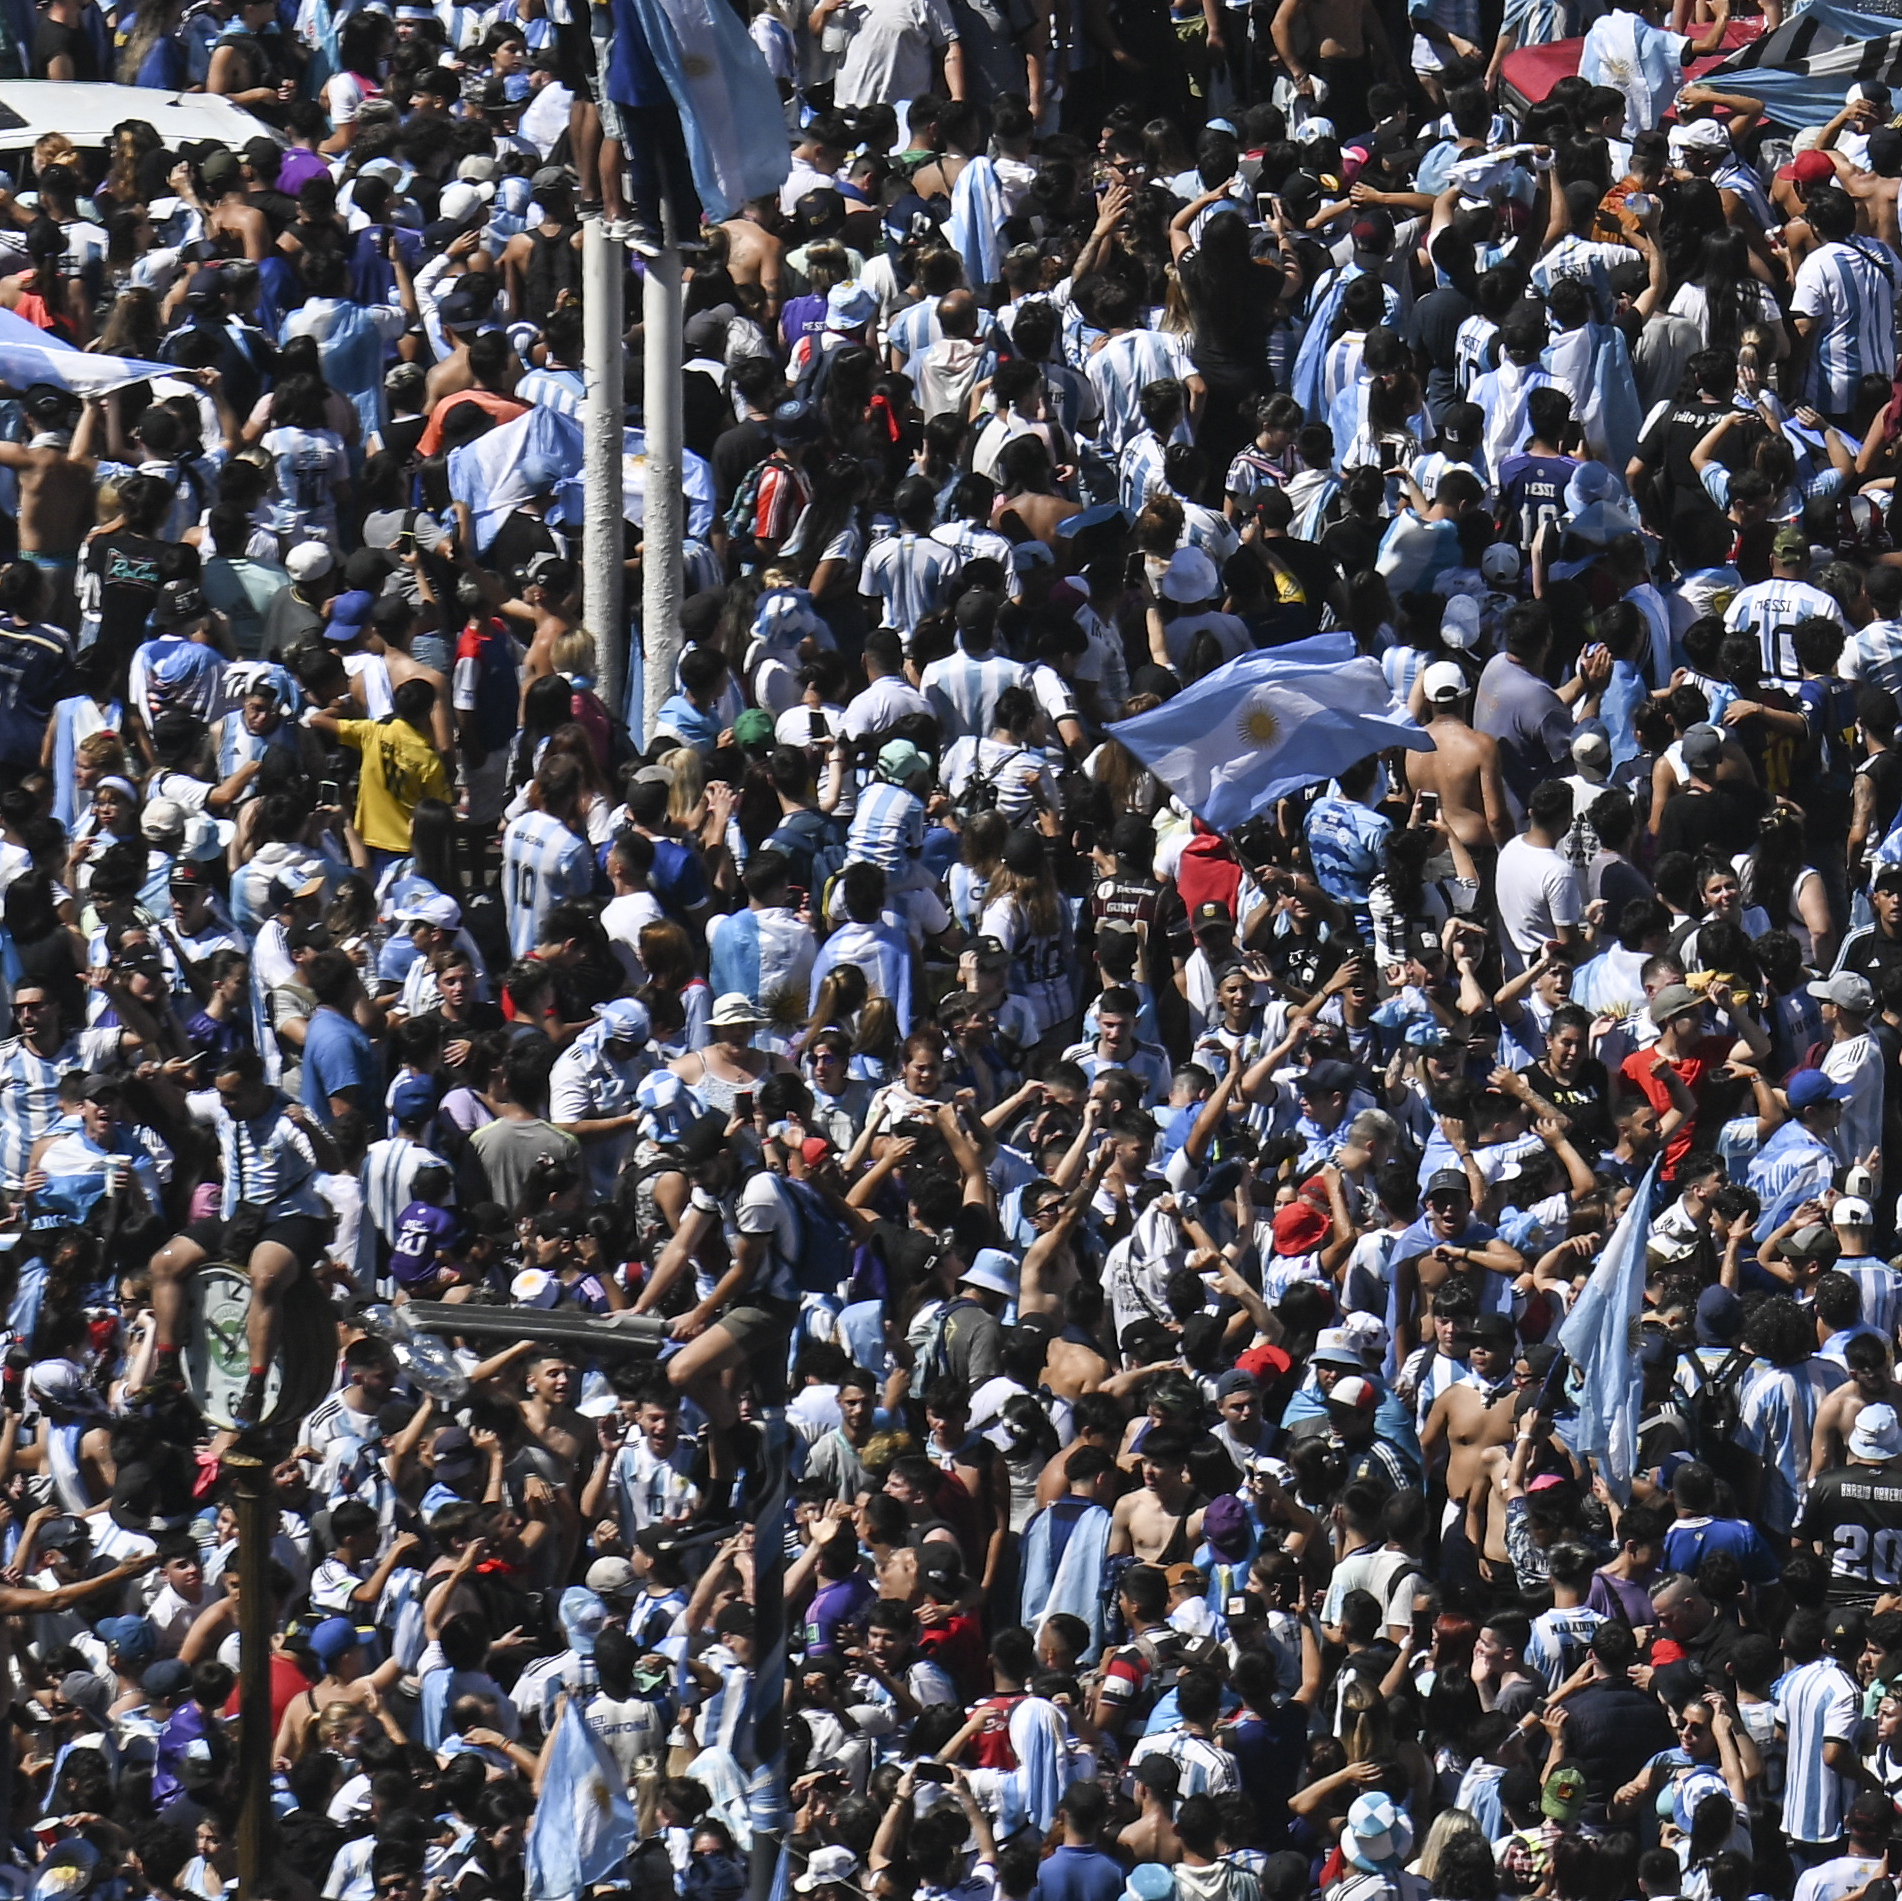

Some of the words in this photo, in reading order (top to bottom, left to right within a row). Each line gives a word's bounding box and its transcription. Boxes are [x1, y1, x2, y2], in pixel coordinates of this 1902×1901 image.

[1551, 263, 1589, 280] MESSI
[1021, 940, 1063, 984] 10
[402, 1230, 427, 1257] 10
